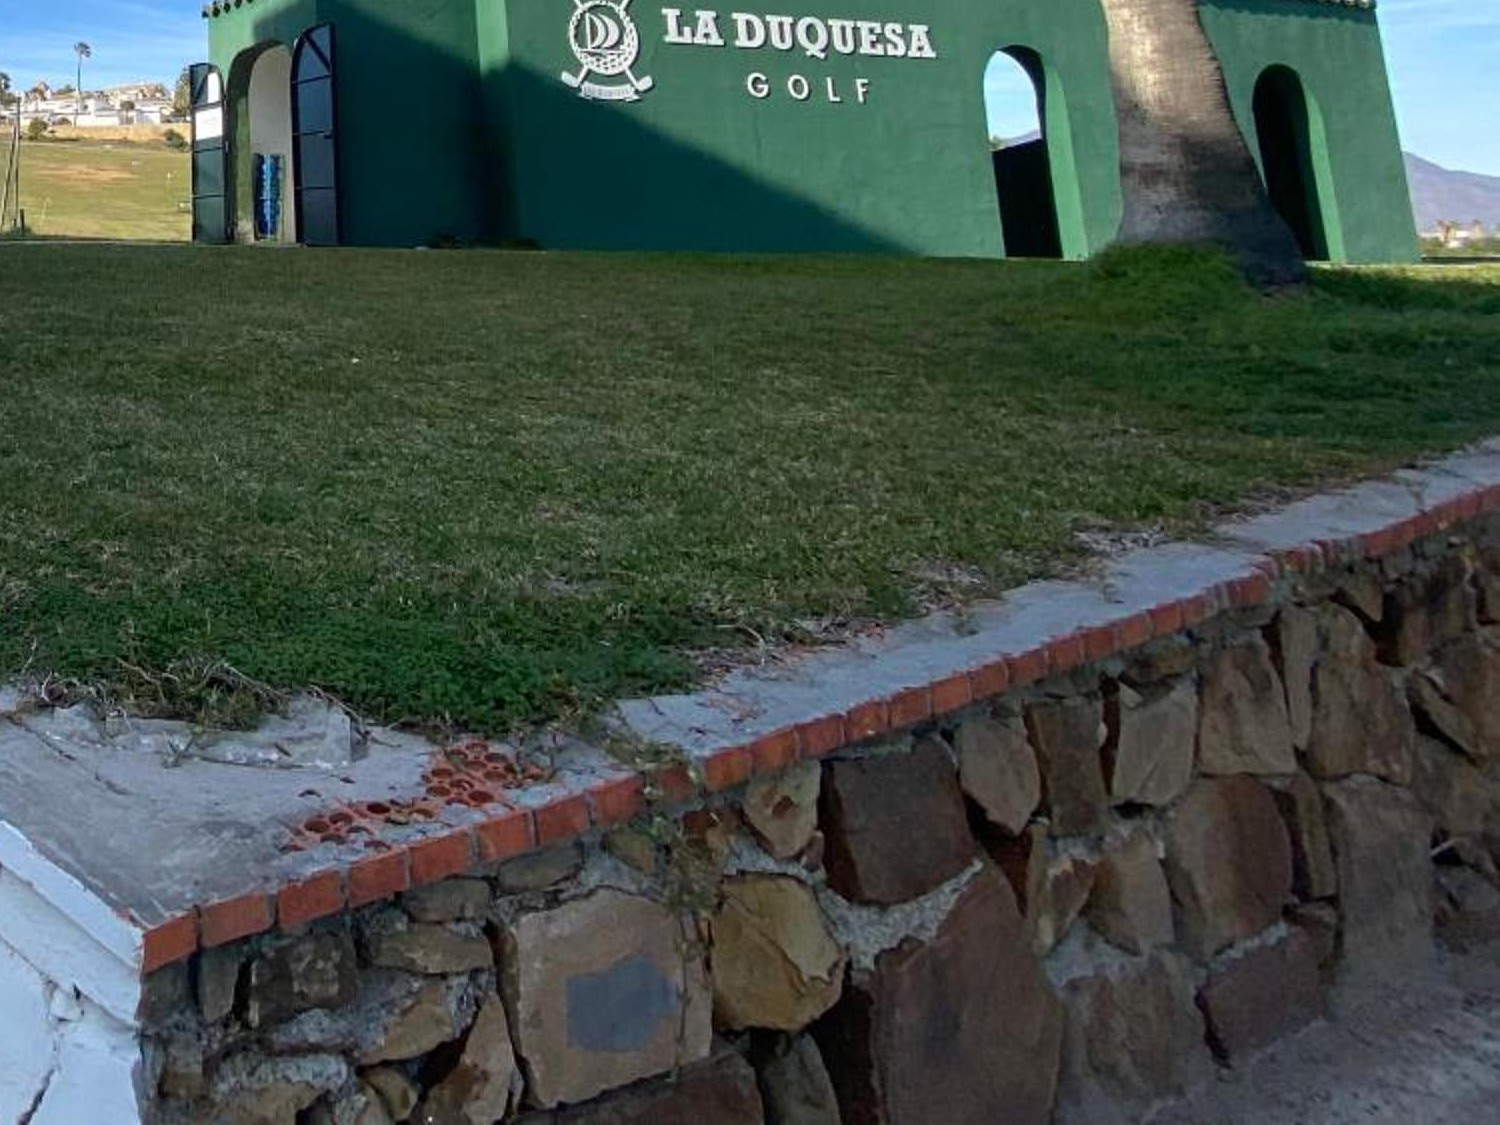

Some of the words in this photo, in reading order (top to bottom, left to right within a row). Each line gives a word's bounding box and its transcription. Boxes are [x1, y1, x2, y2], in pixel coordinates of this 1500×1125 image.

[661, 7, 725, 46] LA
[731, 12, 937, 59] DUQUESA
[746, 72, 870, 104] GOLF
